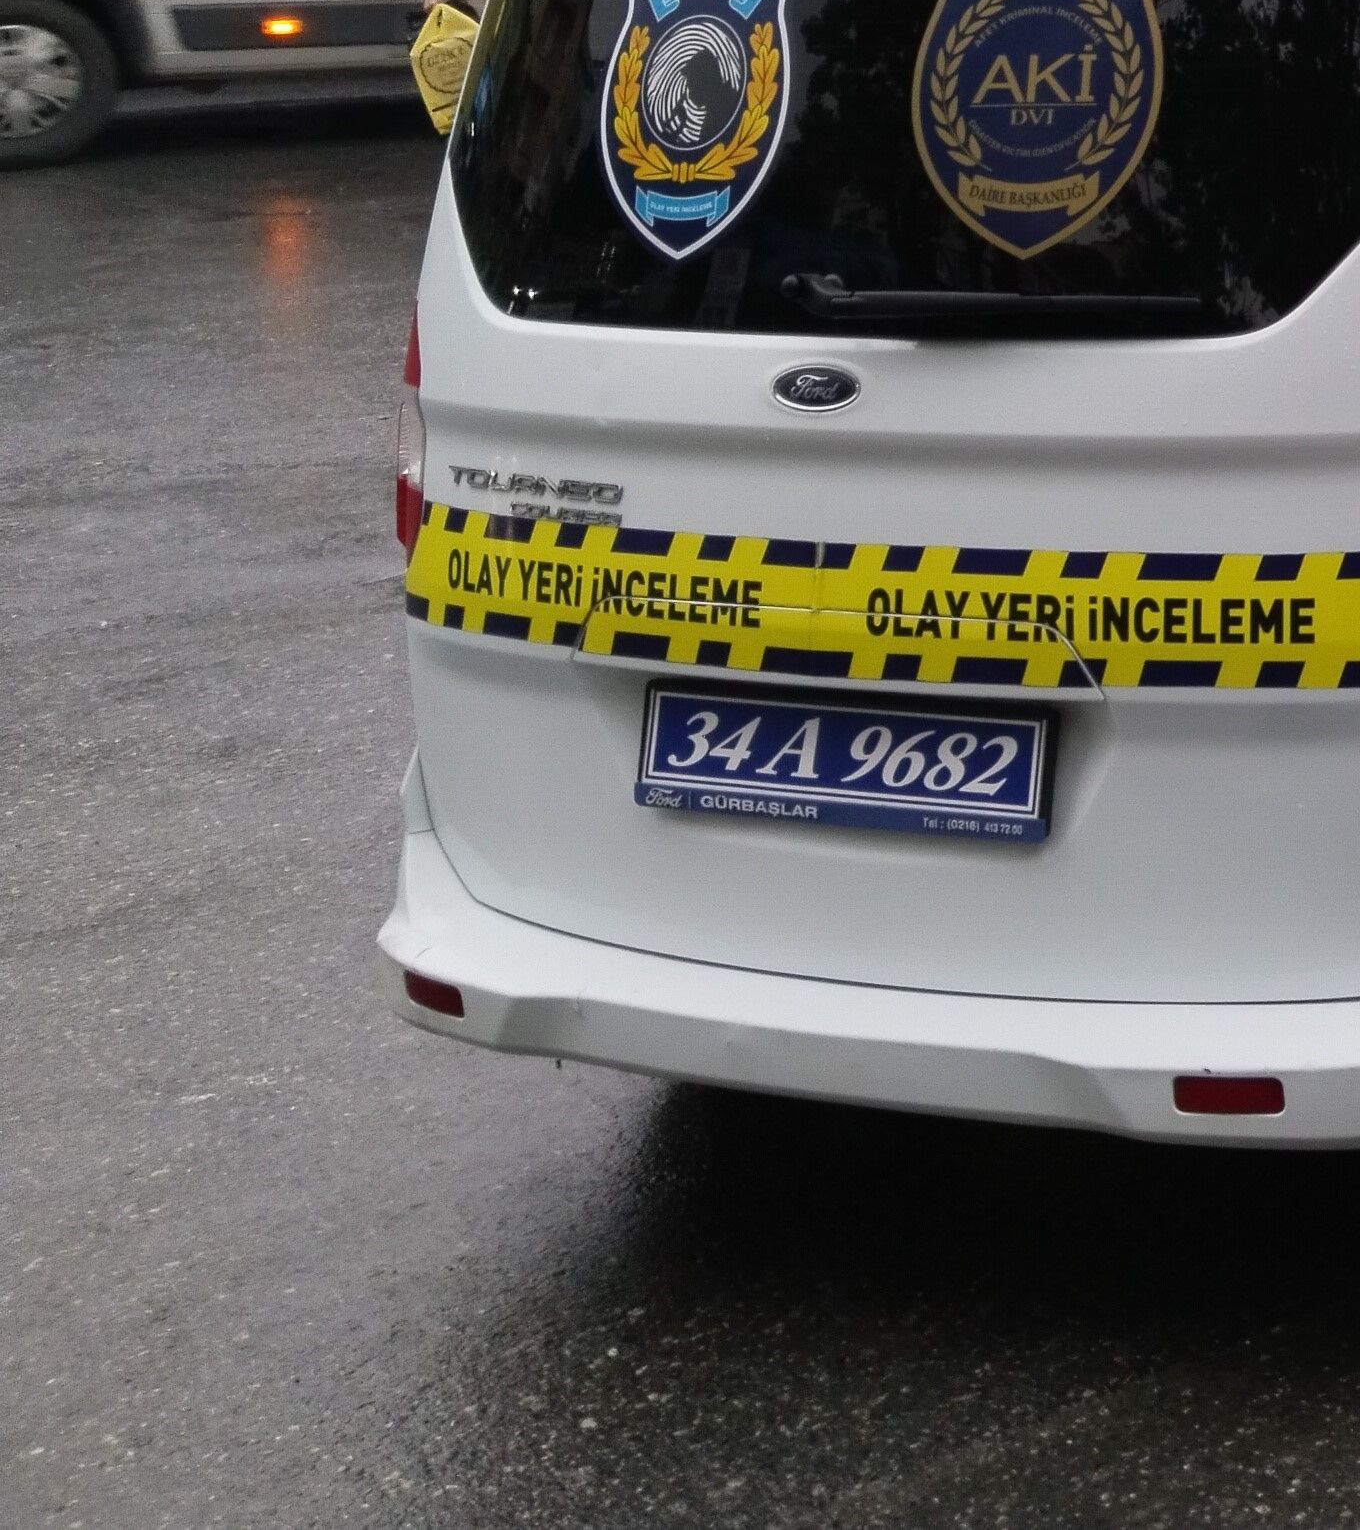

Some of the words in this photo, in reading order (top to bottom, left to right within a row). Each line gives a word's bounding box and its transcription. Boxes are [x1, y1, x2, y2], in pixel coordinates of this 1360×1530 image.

[971, 44, 1098, 103] AKİ
[1009, 108, 1056, 126] DVI
[790, 374, 840, 400] Ford
[448, 465, 625, 505] TOURNEO
[448, 548, 512, 598] OLAY
[518, 558, 584, 607] YERİ
[591, 565, 763, 629] İNCELEME
[865, 587, 972, 640] OLAY
[980, 591, 1075, 642] YERİ
[1088, 595, 1316, 645] İNCELEME
[667, 710, 762, 771] 34
[755, 717, 824, 779] A
[841, 724, 1019, 798] 9682
[645, 787, 683, 809] Ford
[700, 794, 819, 819] GÜRBAŞLAR
